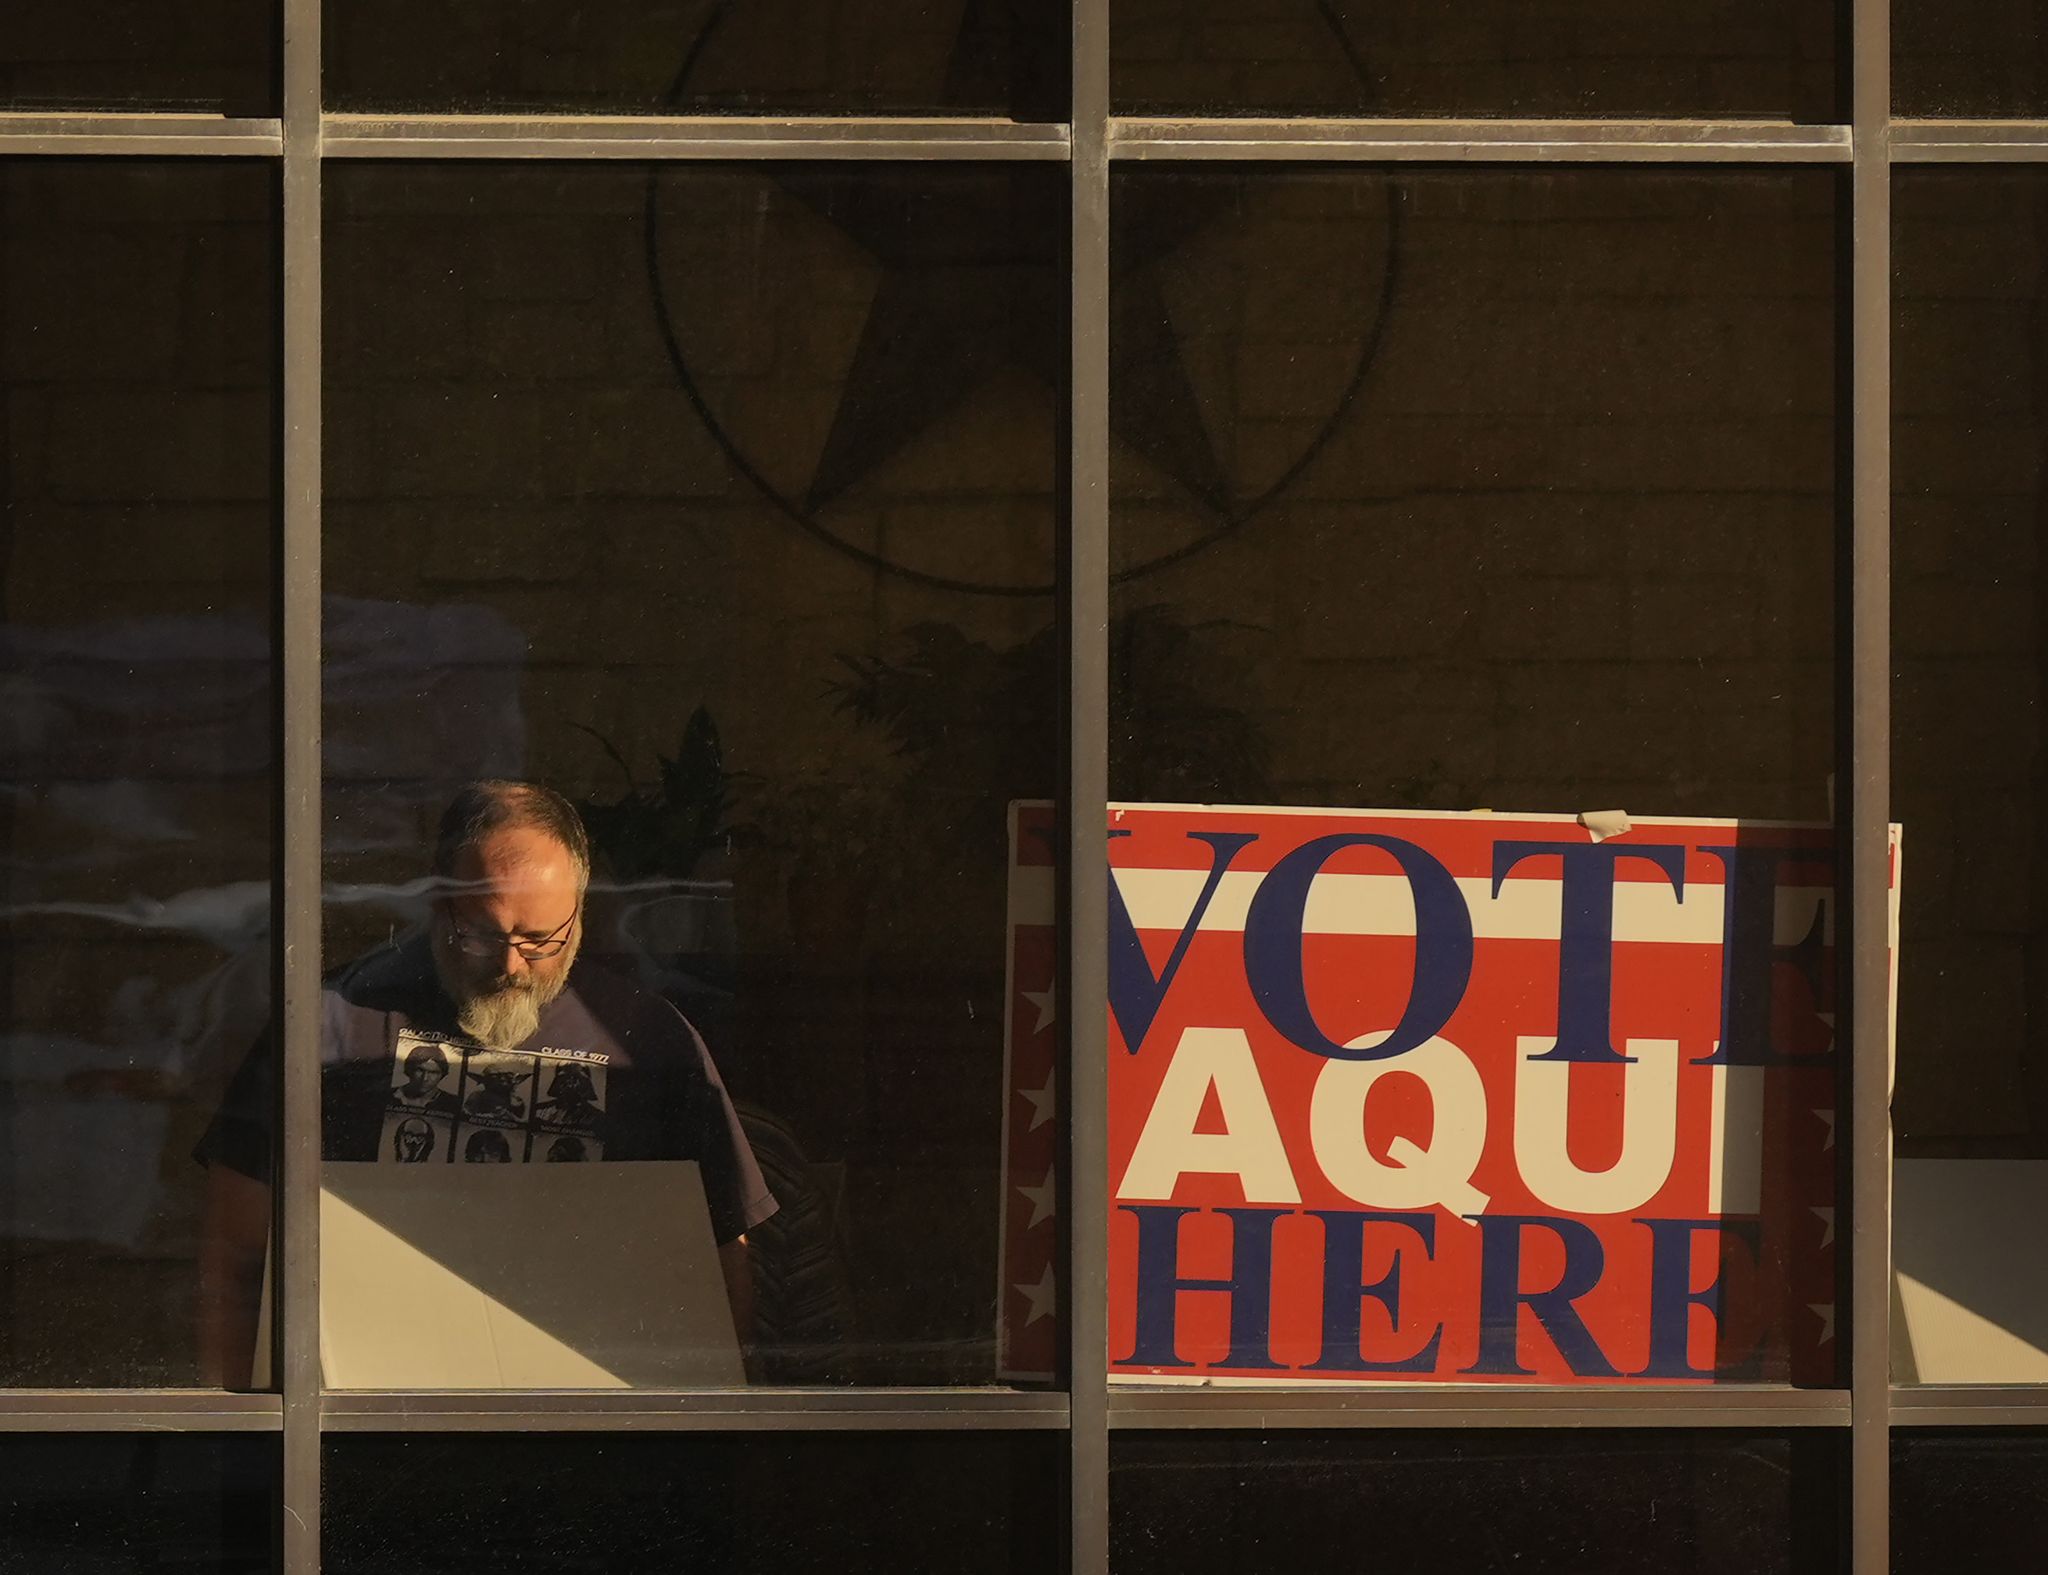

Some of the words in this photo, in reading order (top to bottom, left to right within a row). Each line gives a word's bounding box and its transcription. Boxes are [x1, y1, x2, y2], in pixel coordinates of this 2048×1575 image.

[1029, 832, 1838, 1065] VOTE
[1116, 1026, 1765, 1227] AQUI
[1111, 1203, 1762, 1381] HERE
